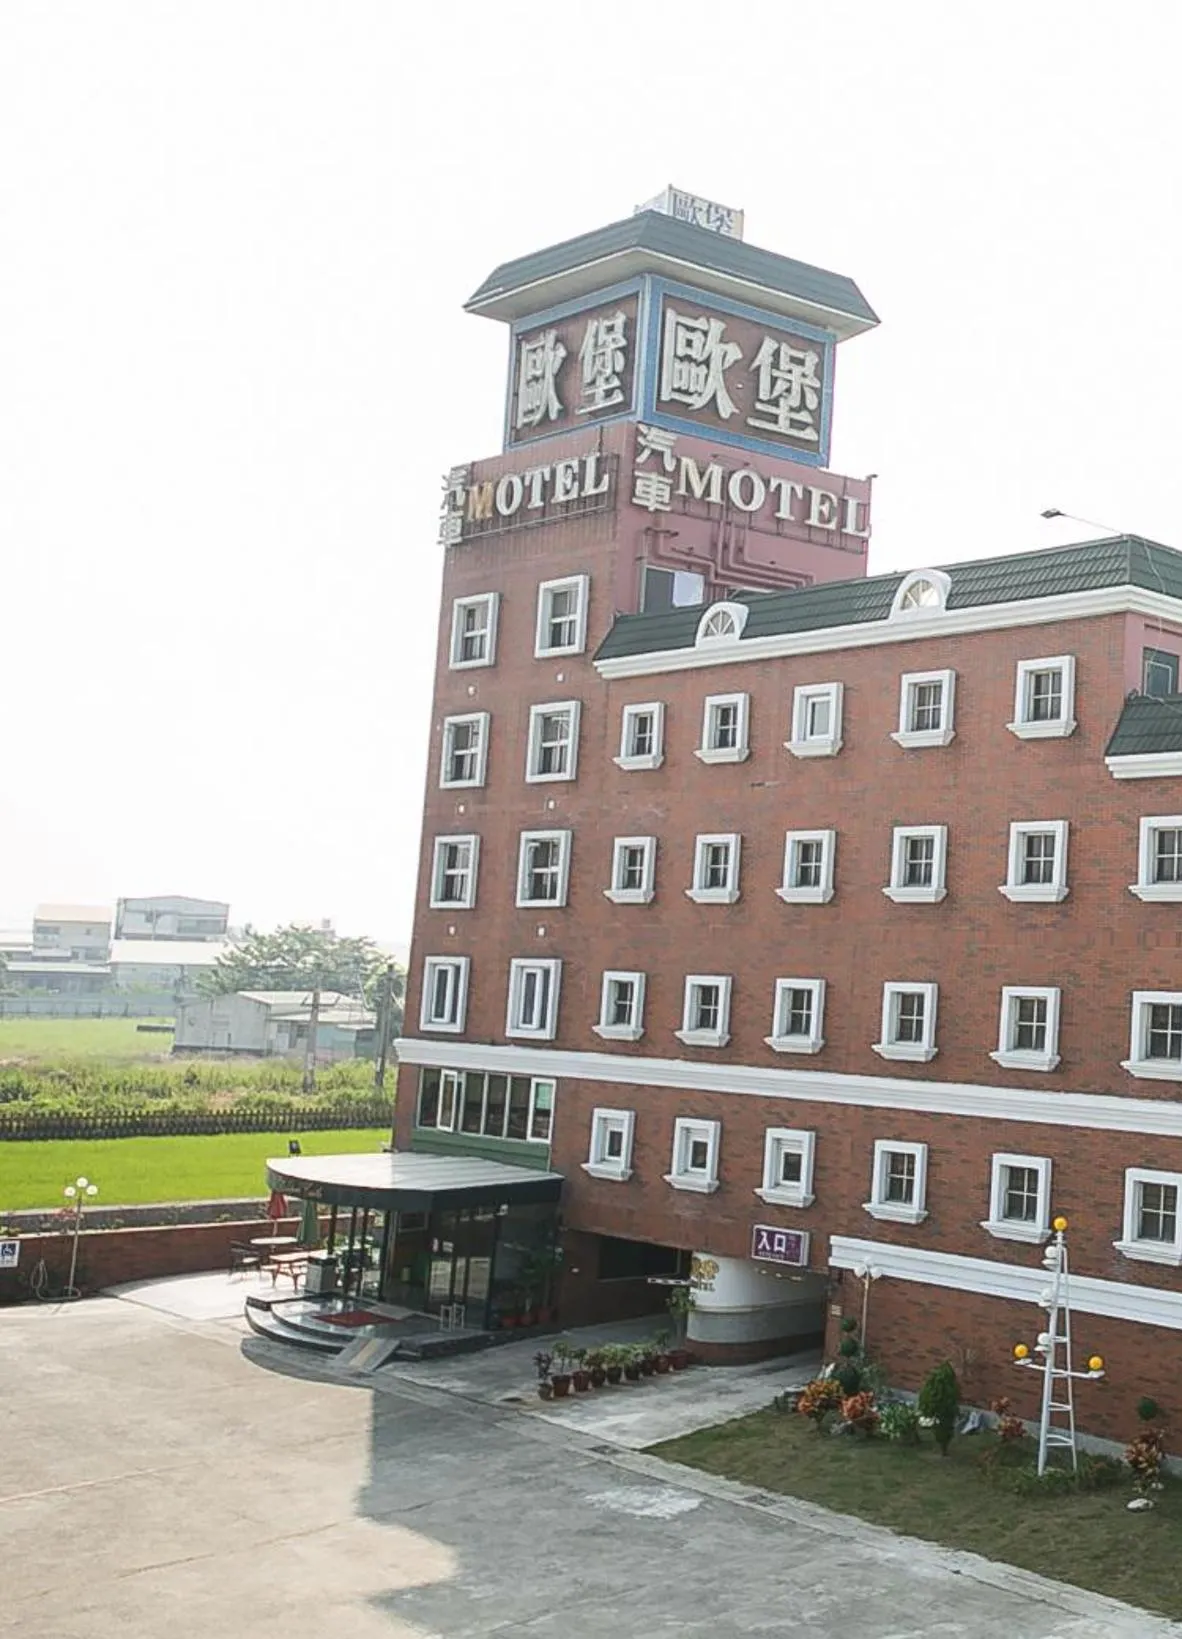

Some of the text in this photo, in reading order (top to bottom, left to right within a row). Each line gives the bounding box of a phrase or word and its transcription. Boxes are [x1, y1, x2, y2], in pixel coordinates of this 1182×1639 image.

[517, 310, 627, 428] 歐堡
[660, 307, 821, 441] 歐堡
[467, 452, 609, 522] MOTEL
[632, 424, 677, 512] 汽車
[675, 456, 871, 537] MOTEL
[758, 1231, 786, 1253] 入口
